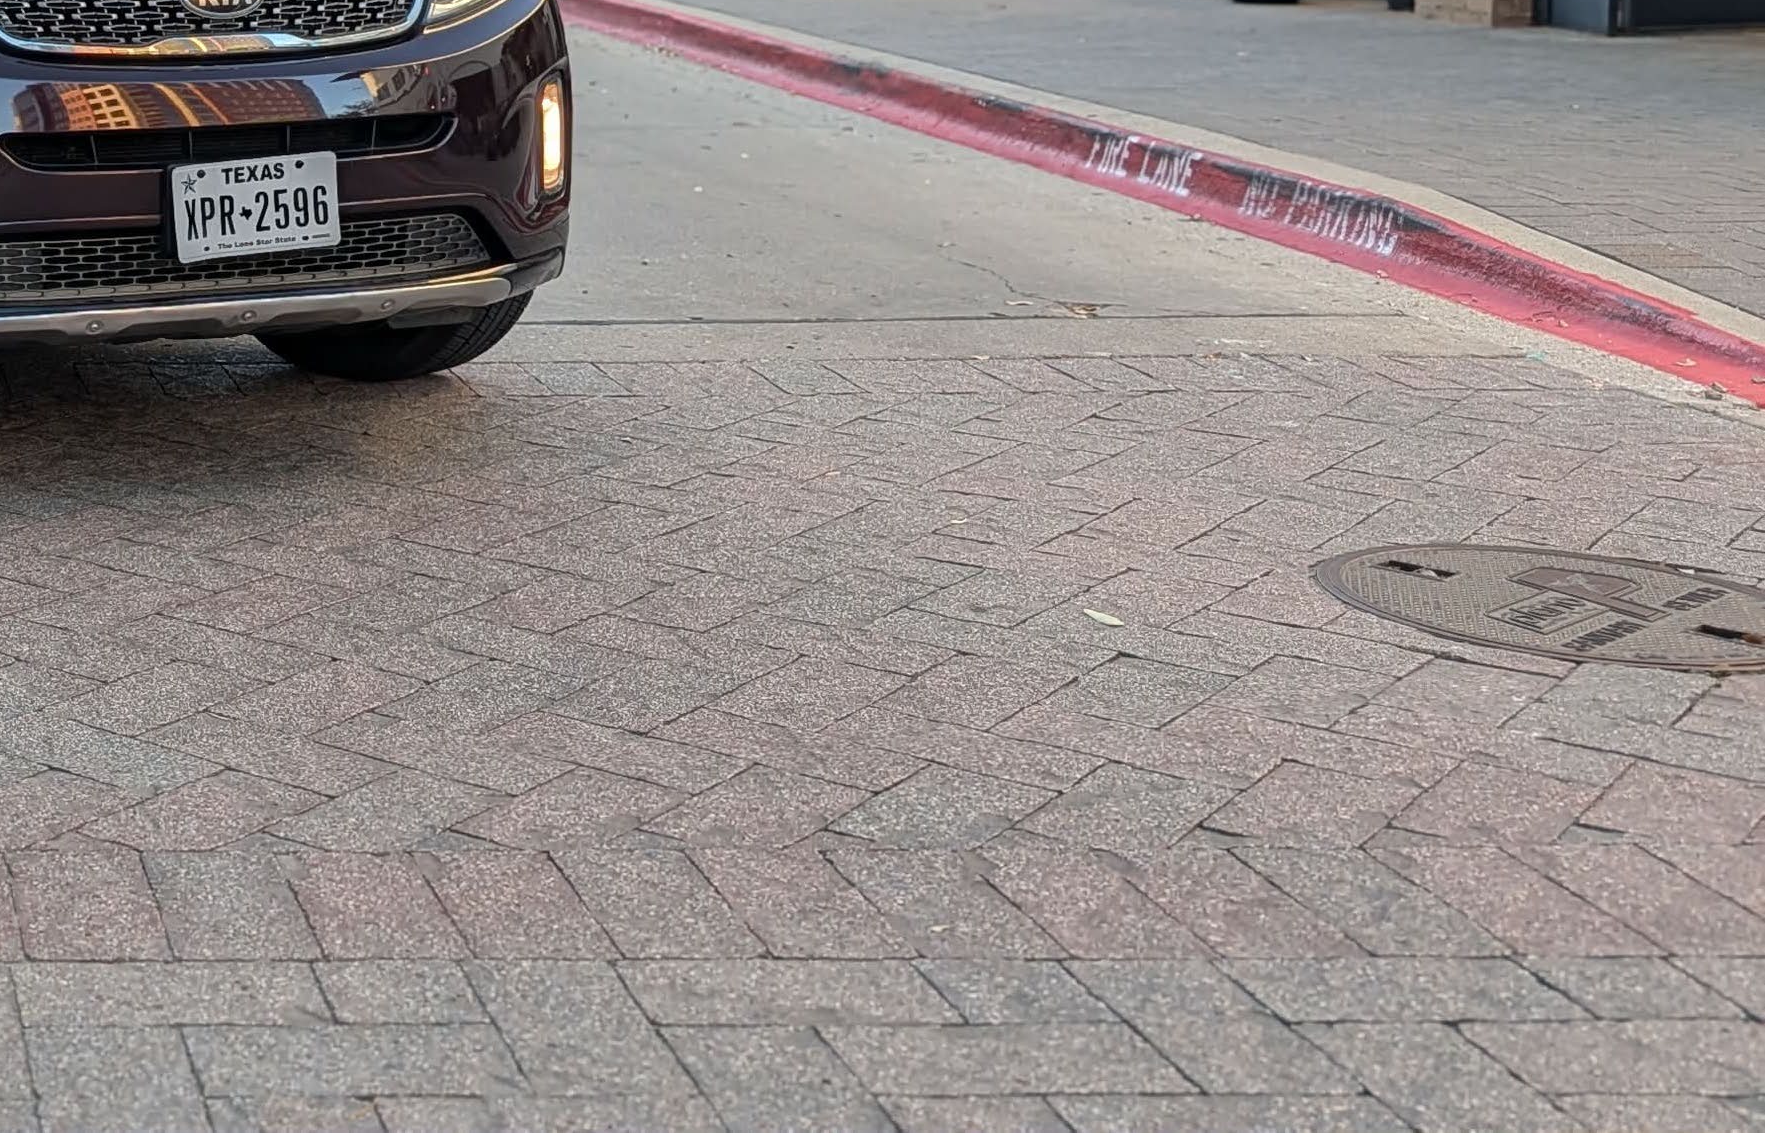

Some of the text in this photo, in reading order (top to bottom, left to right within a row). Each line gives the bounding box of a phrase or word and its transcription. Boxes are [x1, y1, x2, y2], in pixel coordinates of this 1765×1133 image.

[220, 162, 285, 185] TEXAS
[1137, 140, 1204, 197] LANE
[184, 185, 329, 241] XPR 2596
